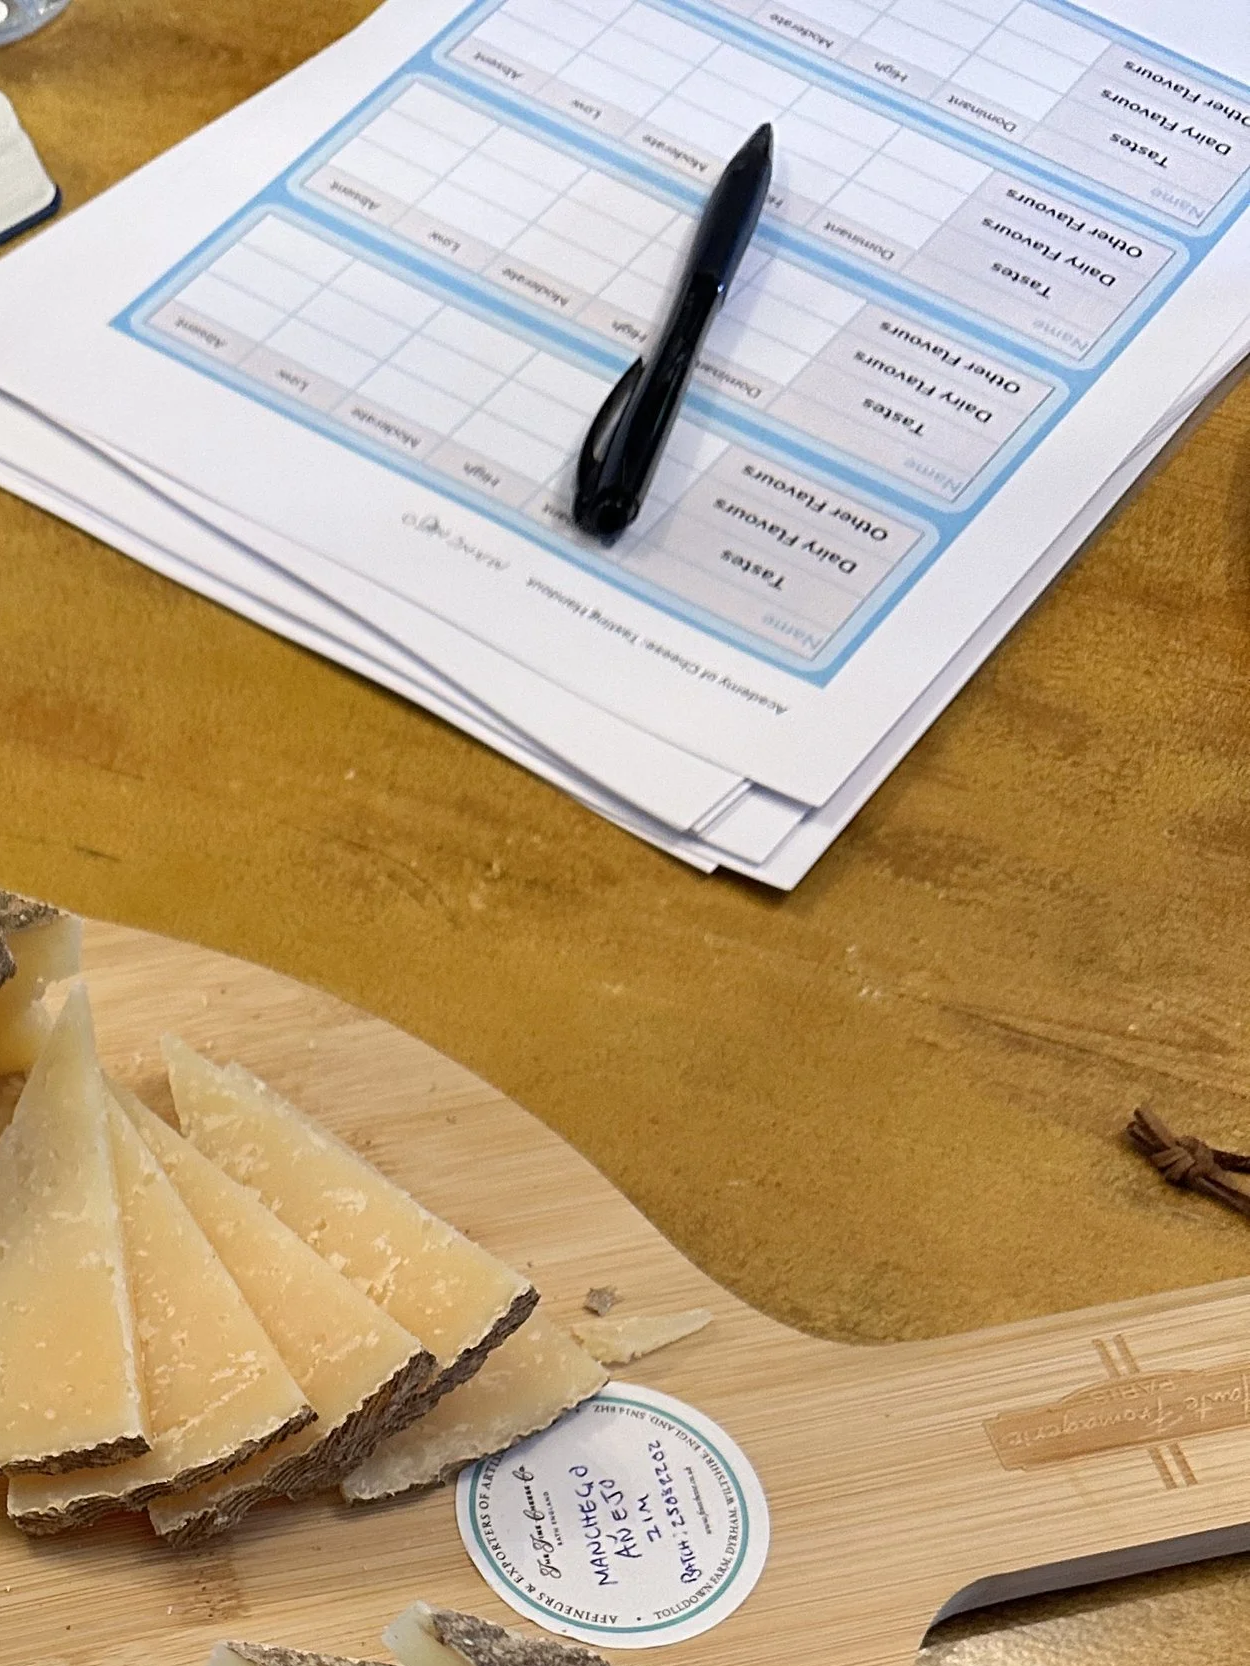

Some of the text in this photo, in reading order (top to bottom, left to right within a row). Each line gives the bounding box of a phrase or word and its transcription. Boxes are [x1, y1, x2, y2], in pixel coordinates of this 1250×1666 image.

[770, 12, 834, 50] Moderate
[471, 51, 525, 81] Absent
[874, 61, 909, 83] High
[1124, 59, 1202, 104] Flavours
[572, 98, 603, 121] Low
[948, 95, 1018, 134] Dominant
[1100, 87, 1232, 156] Dairy Flavours
[642, 132, 709, 174] Moderate
[1109, 132, 1169, 169] Tastes
[823, 221, 895, 261] Dominant
[1007, 188, 1143, 259] Other Flavours
[981, 217, 1116, 288] Dairy Flavours
[991, 260, 1052, 300] Tastes
[879, 319, 1020, 395] Other Flavours
[853, 350, 994, 425] Dairy Flavours
[863, 397, 925, 438] Tastes
[742, 463, 889, 543] Other Flavours
[712, 497, 858, 576] Dairy Flavours
[721, 547, 785, 592] Tastes
[478, 1493, 490, 1510] OF
[542, 1491, 564, 1546] BATH ENGLAND
[569, 1465, 618, 1586] MANCHEGO
[479, 1513, 525, 1584] EXPORTERS
[524, 1582, 536, 1594] &
[536, 1592, 619, 1624] AFFINEURS
[653, 1585, 712, 1621] TOLLDOWN
